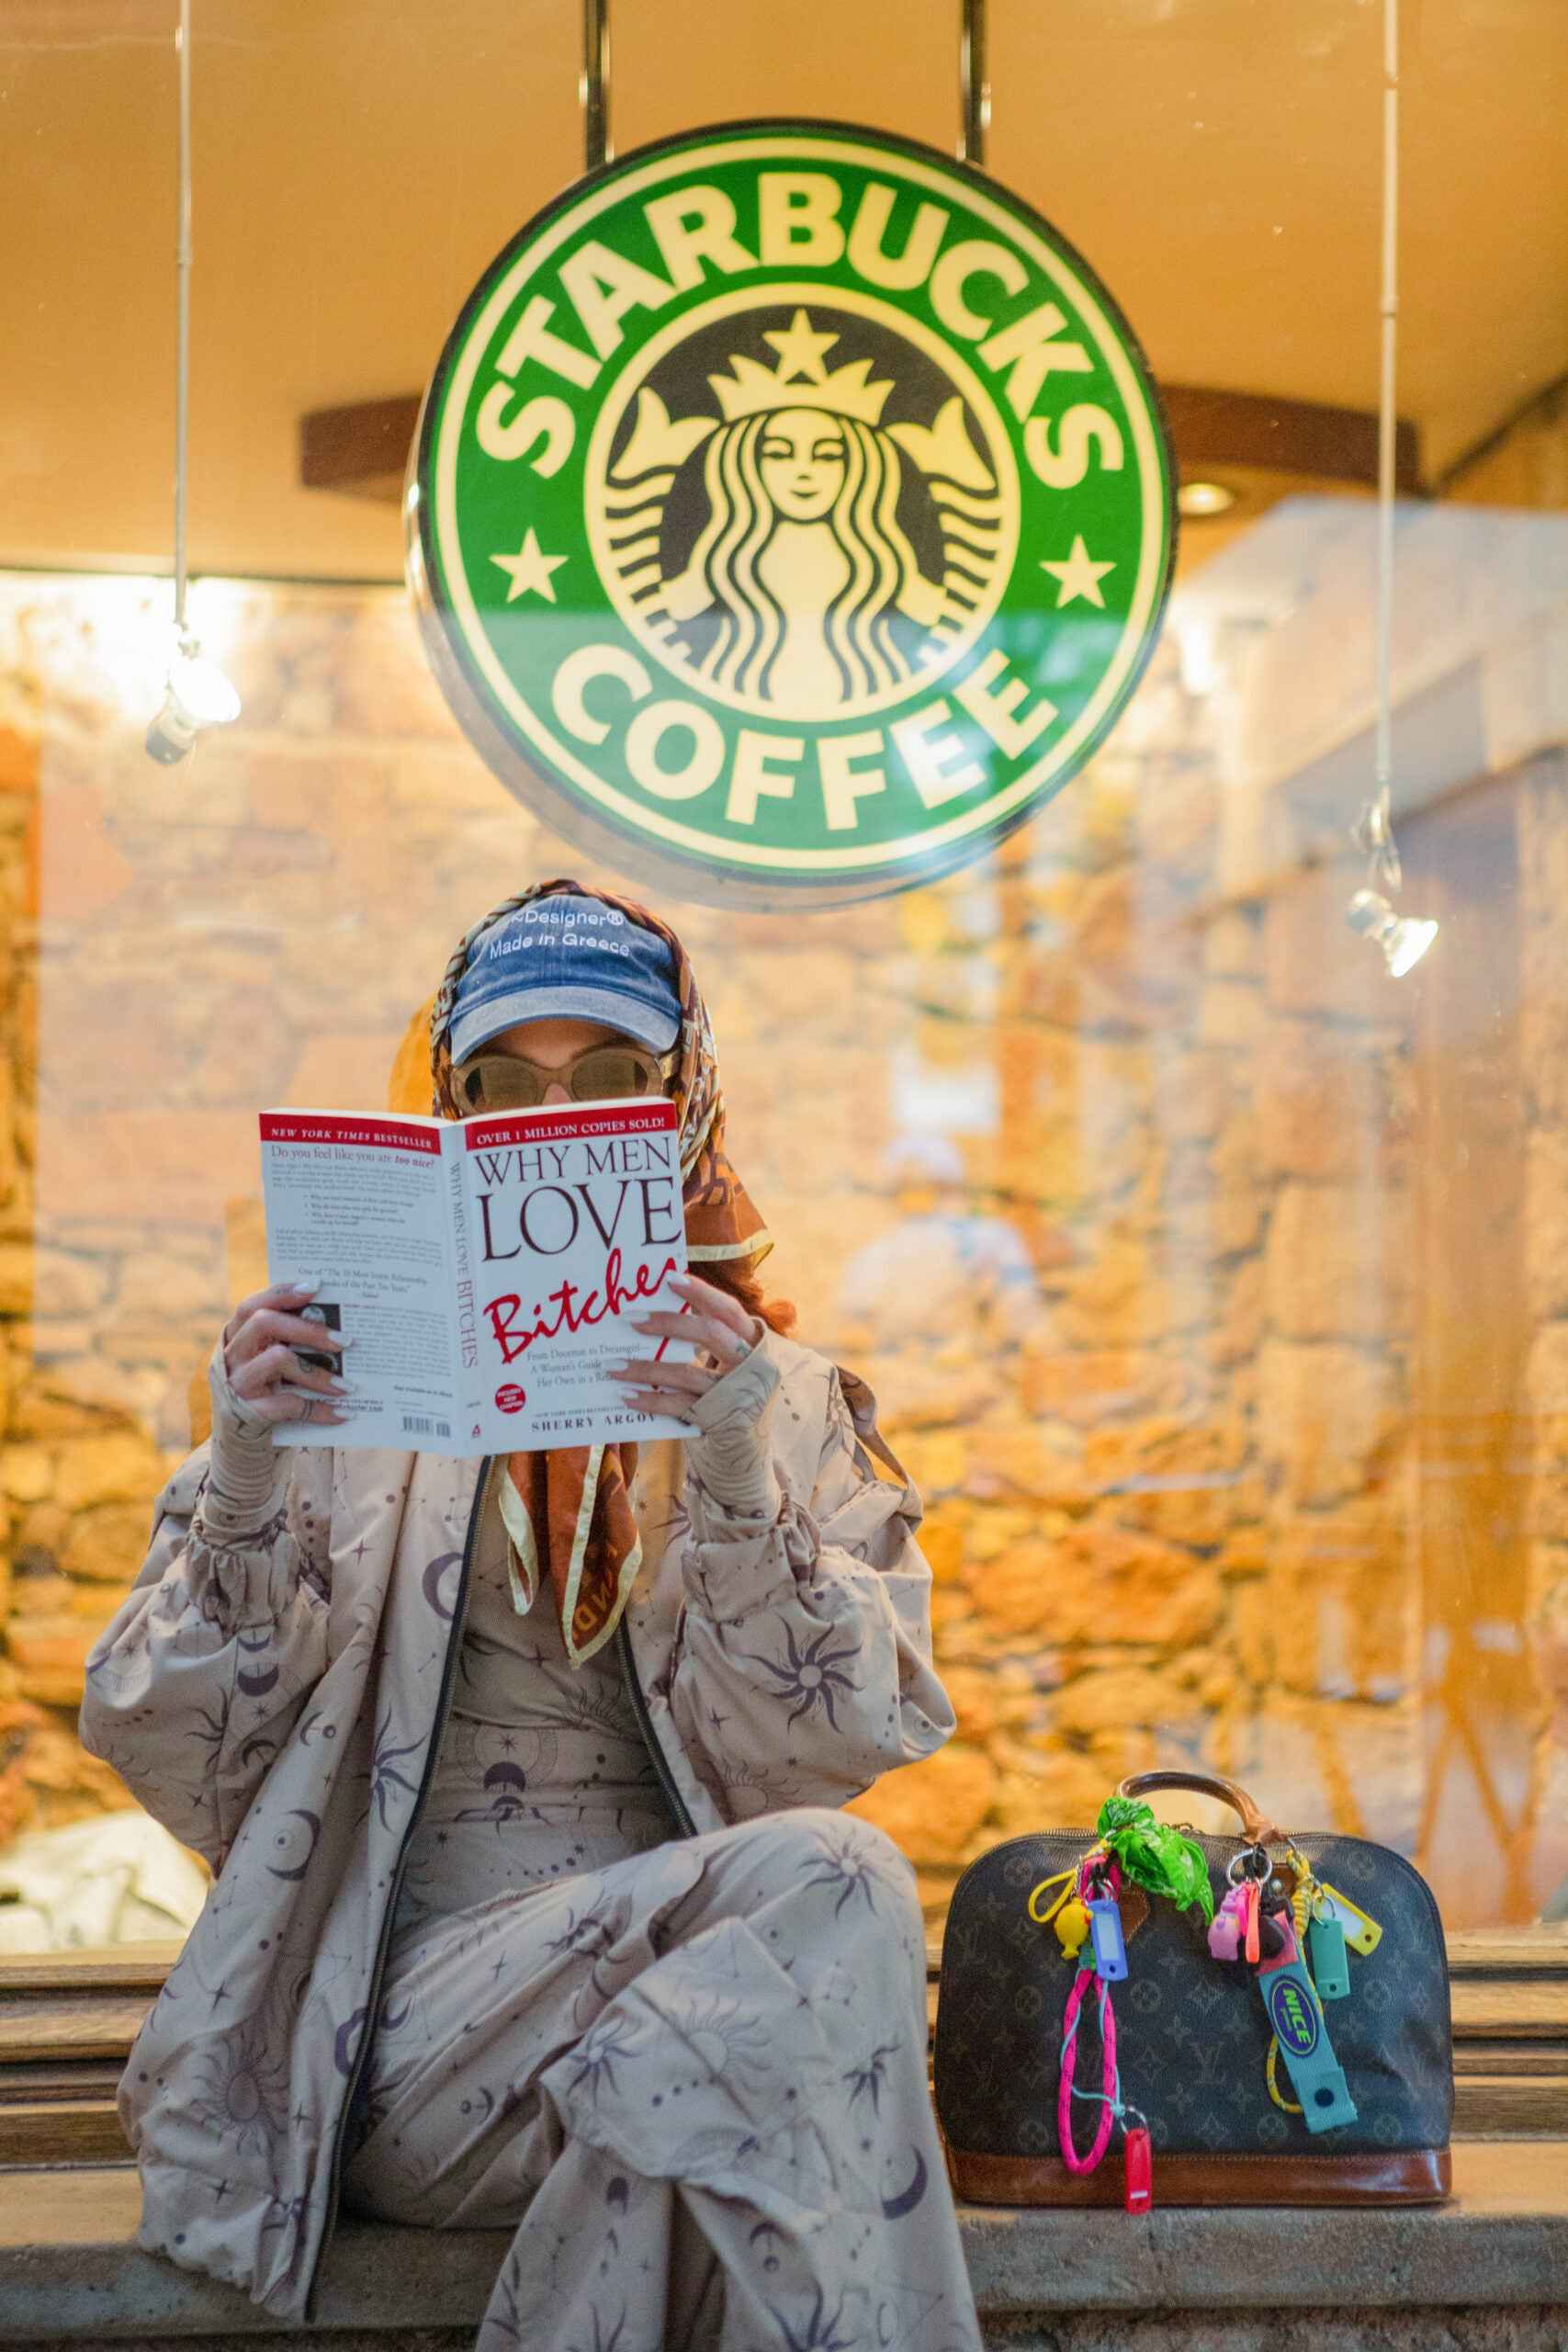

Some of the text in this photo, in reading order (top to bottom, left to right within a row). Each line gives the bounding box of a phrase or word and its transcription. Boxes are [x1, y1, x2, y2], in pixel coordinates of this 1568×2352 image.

[475, 171, 1124, 490] STARBUCKS
[551, 643, 1059, 831] COFFEE
[490, 935, 533, 960] Made
[562, 933, 629, 957] Greece
[271, 1127, 433, 1148] NEW YORK TIMES BESTSELLER
[271, 1145, 288, 1159] Do
[290, 1149, 311, 1161] you
[314, 1147, 332, 1159] feel
[334, 1148, 354, 1161] like
[355, 1152, 375, 1164] you
[378, 1154, 391, 1163] are
[395, 1155, 410, 1166] too
[477, 1116, 666, 1146] OVER 1 MILLION COPIES SOLD!
[473, 1145, 571, 1187] WHY
[583, 1136, 671, 1177] MEN
[476, 1175, 682, 1263] LOVE
[449, 1162, 479, 1370] WHY MEN LOVE BITCHES
[531, 1415, 594, 1432] SHERRY
[1282, 1988, 1312, 2044] NICE
